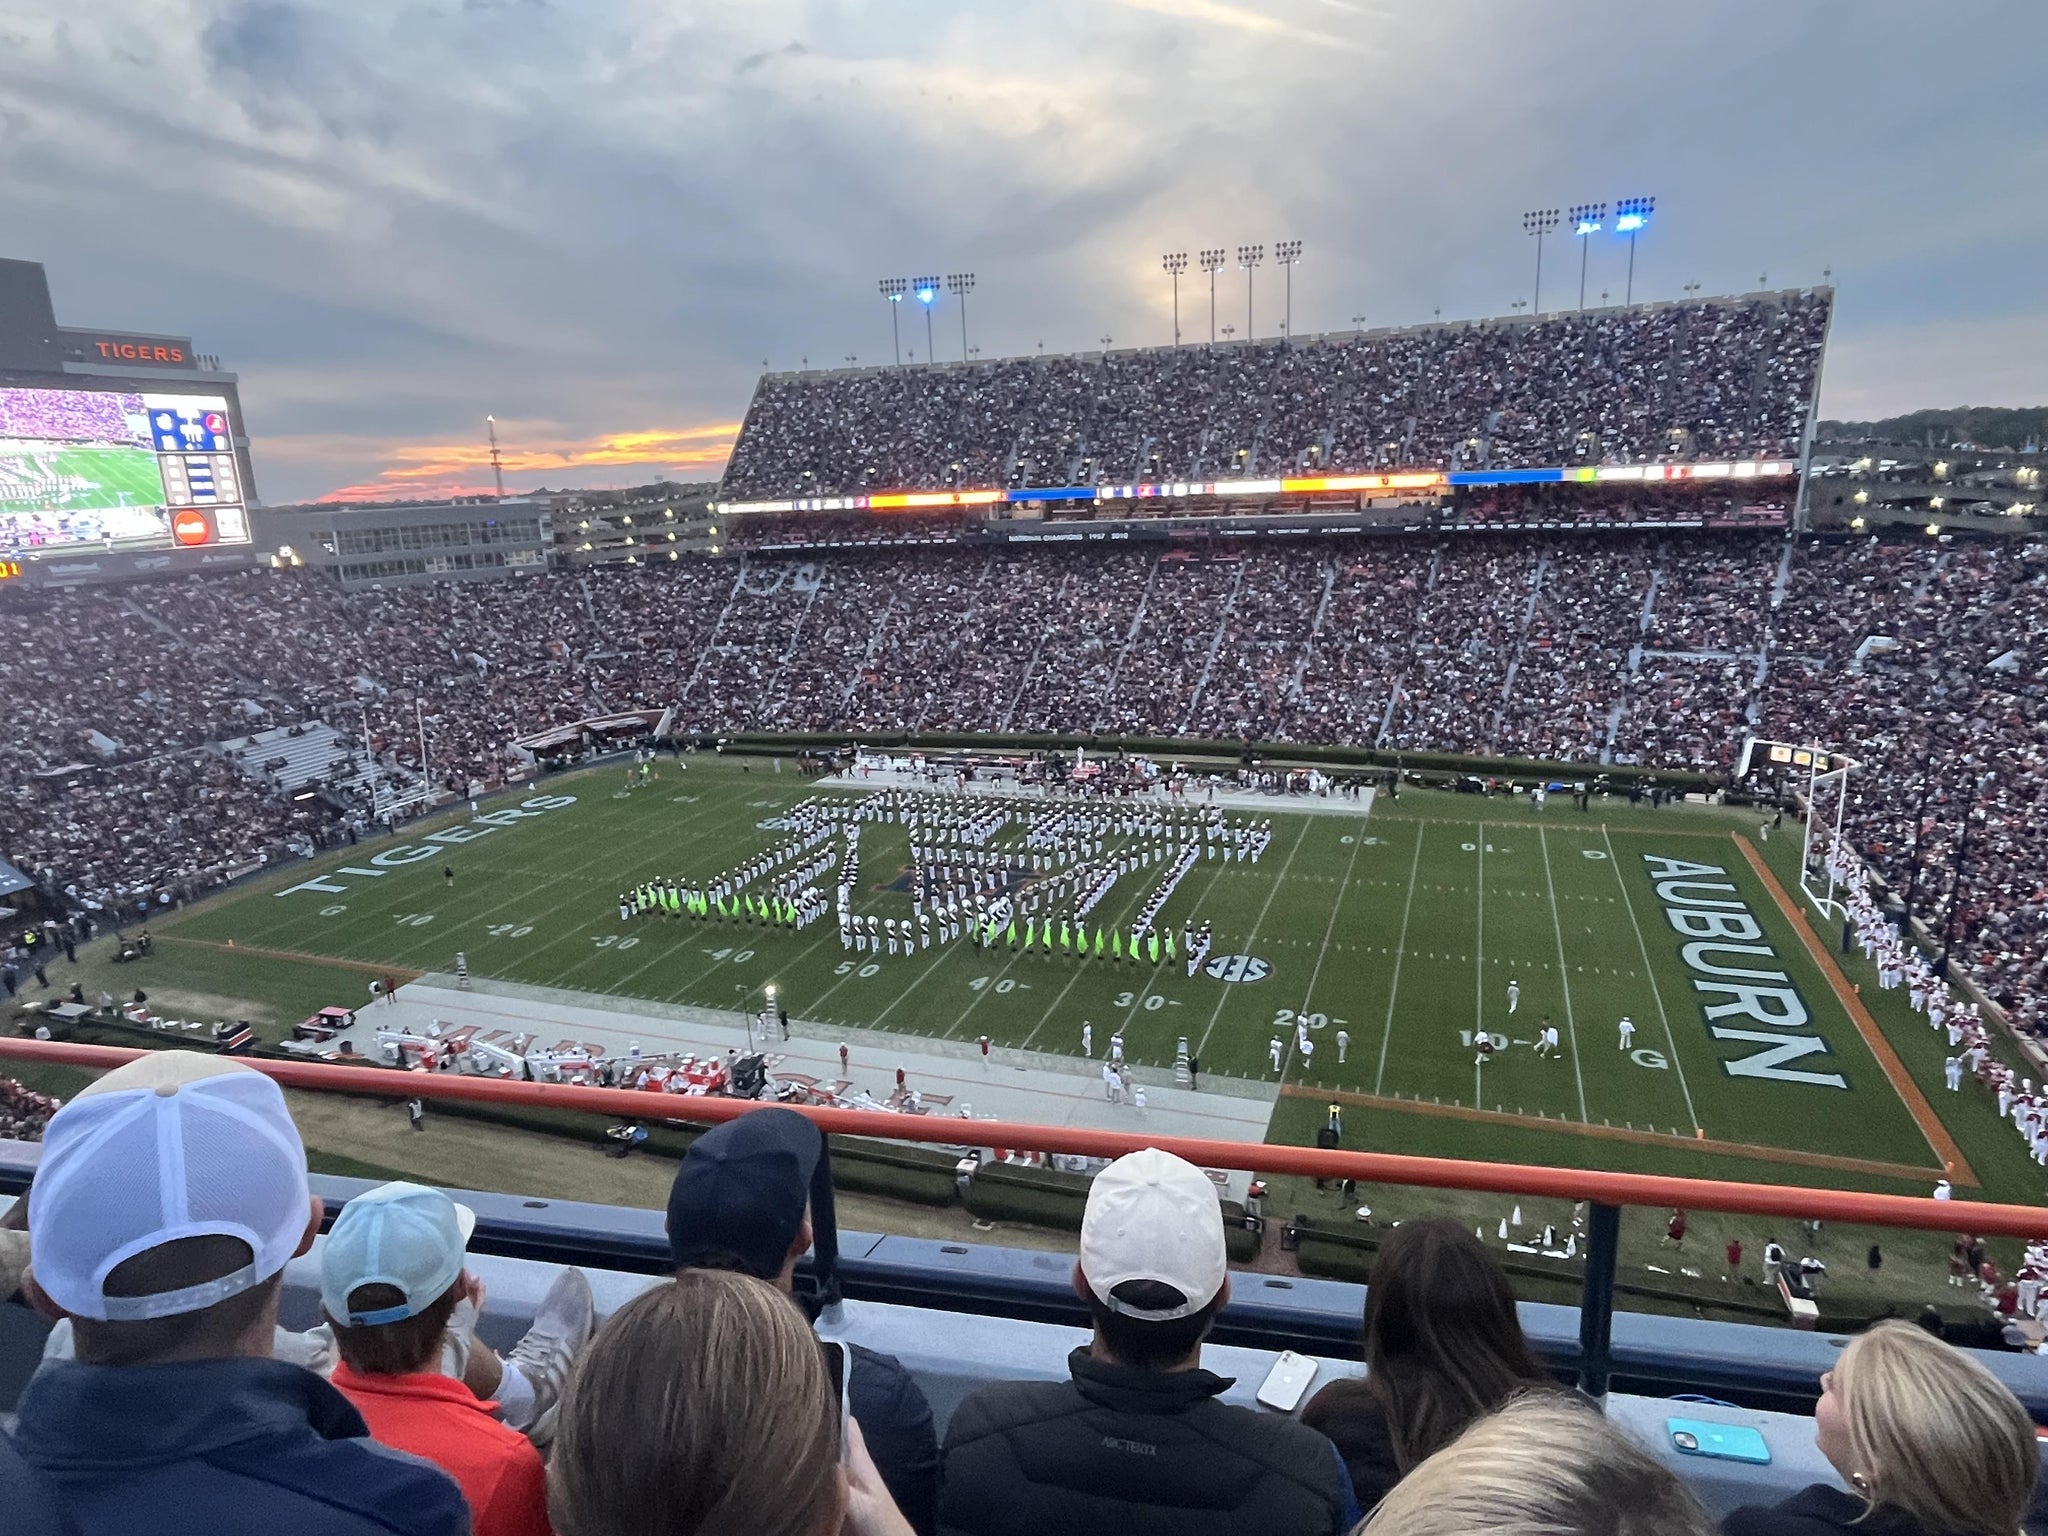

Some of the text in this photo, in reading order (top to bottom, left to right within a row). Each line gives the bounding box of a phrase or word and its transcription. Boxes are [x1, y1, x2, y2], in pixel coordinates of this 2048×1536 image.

[95, 342, 183, 362] TIGERS
[273, 794, 578, 897] TIGERS
[595, 934, 641, 950] 30
[709, 947, 756, 963] 40
[833, 960, 880, 978] 50
[1205, 954, 1270, 983] SEC
[1642, 853, 1849, 1090] AUBURN
[967, 975, 1017, 994] 40
[1112, 991, 1165, 1012] 30
[1272, 1008, 1328, 1030] 20
[1630, 1048, 1669, 1070] G
